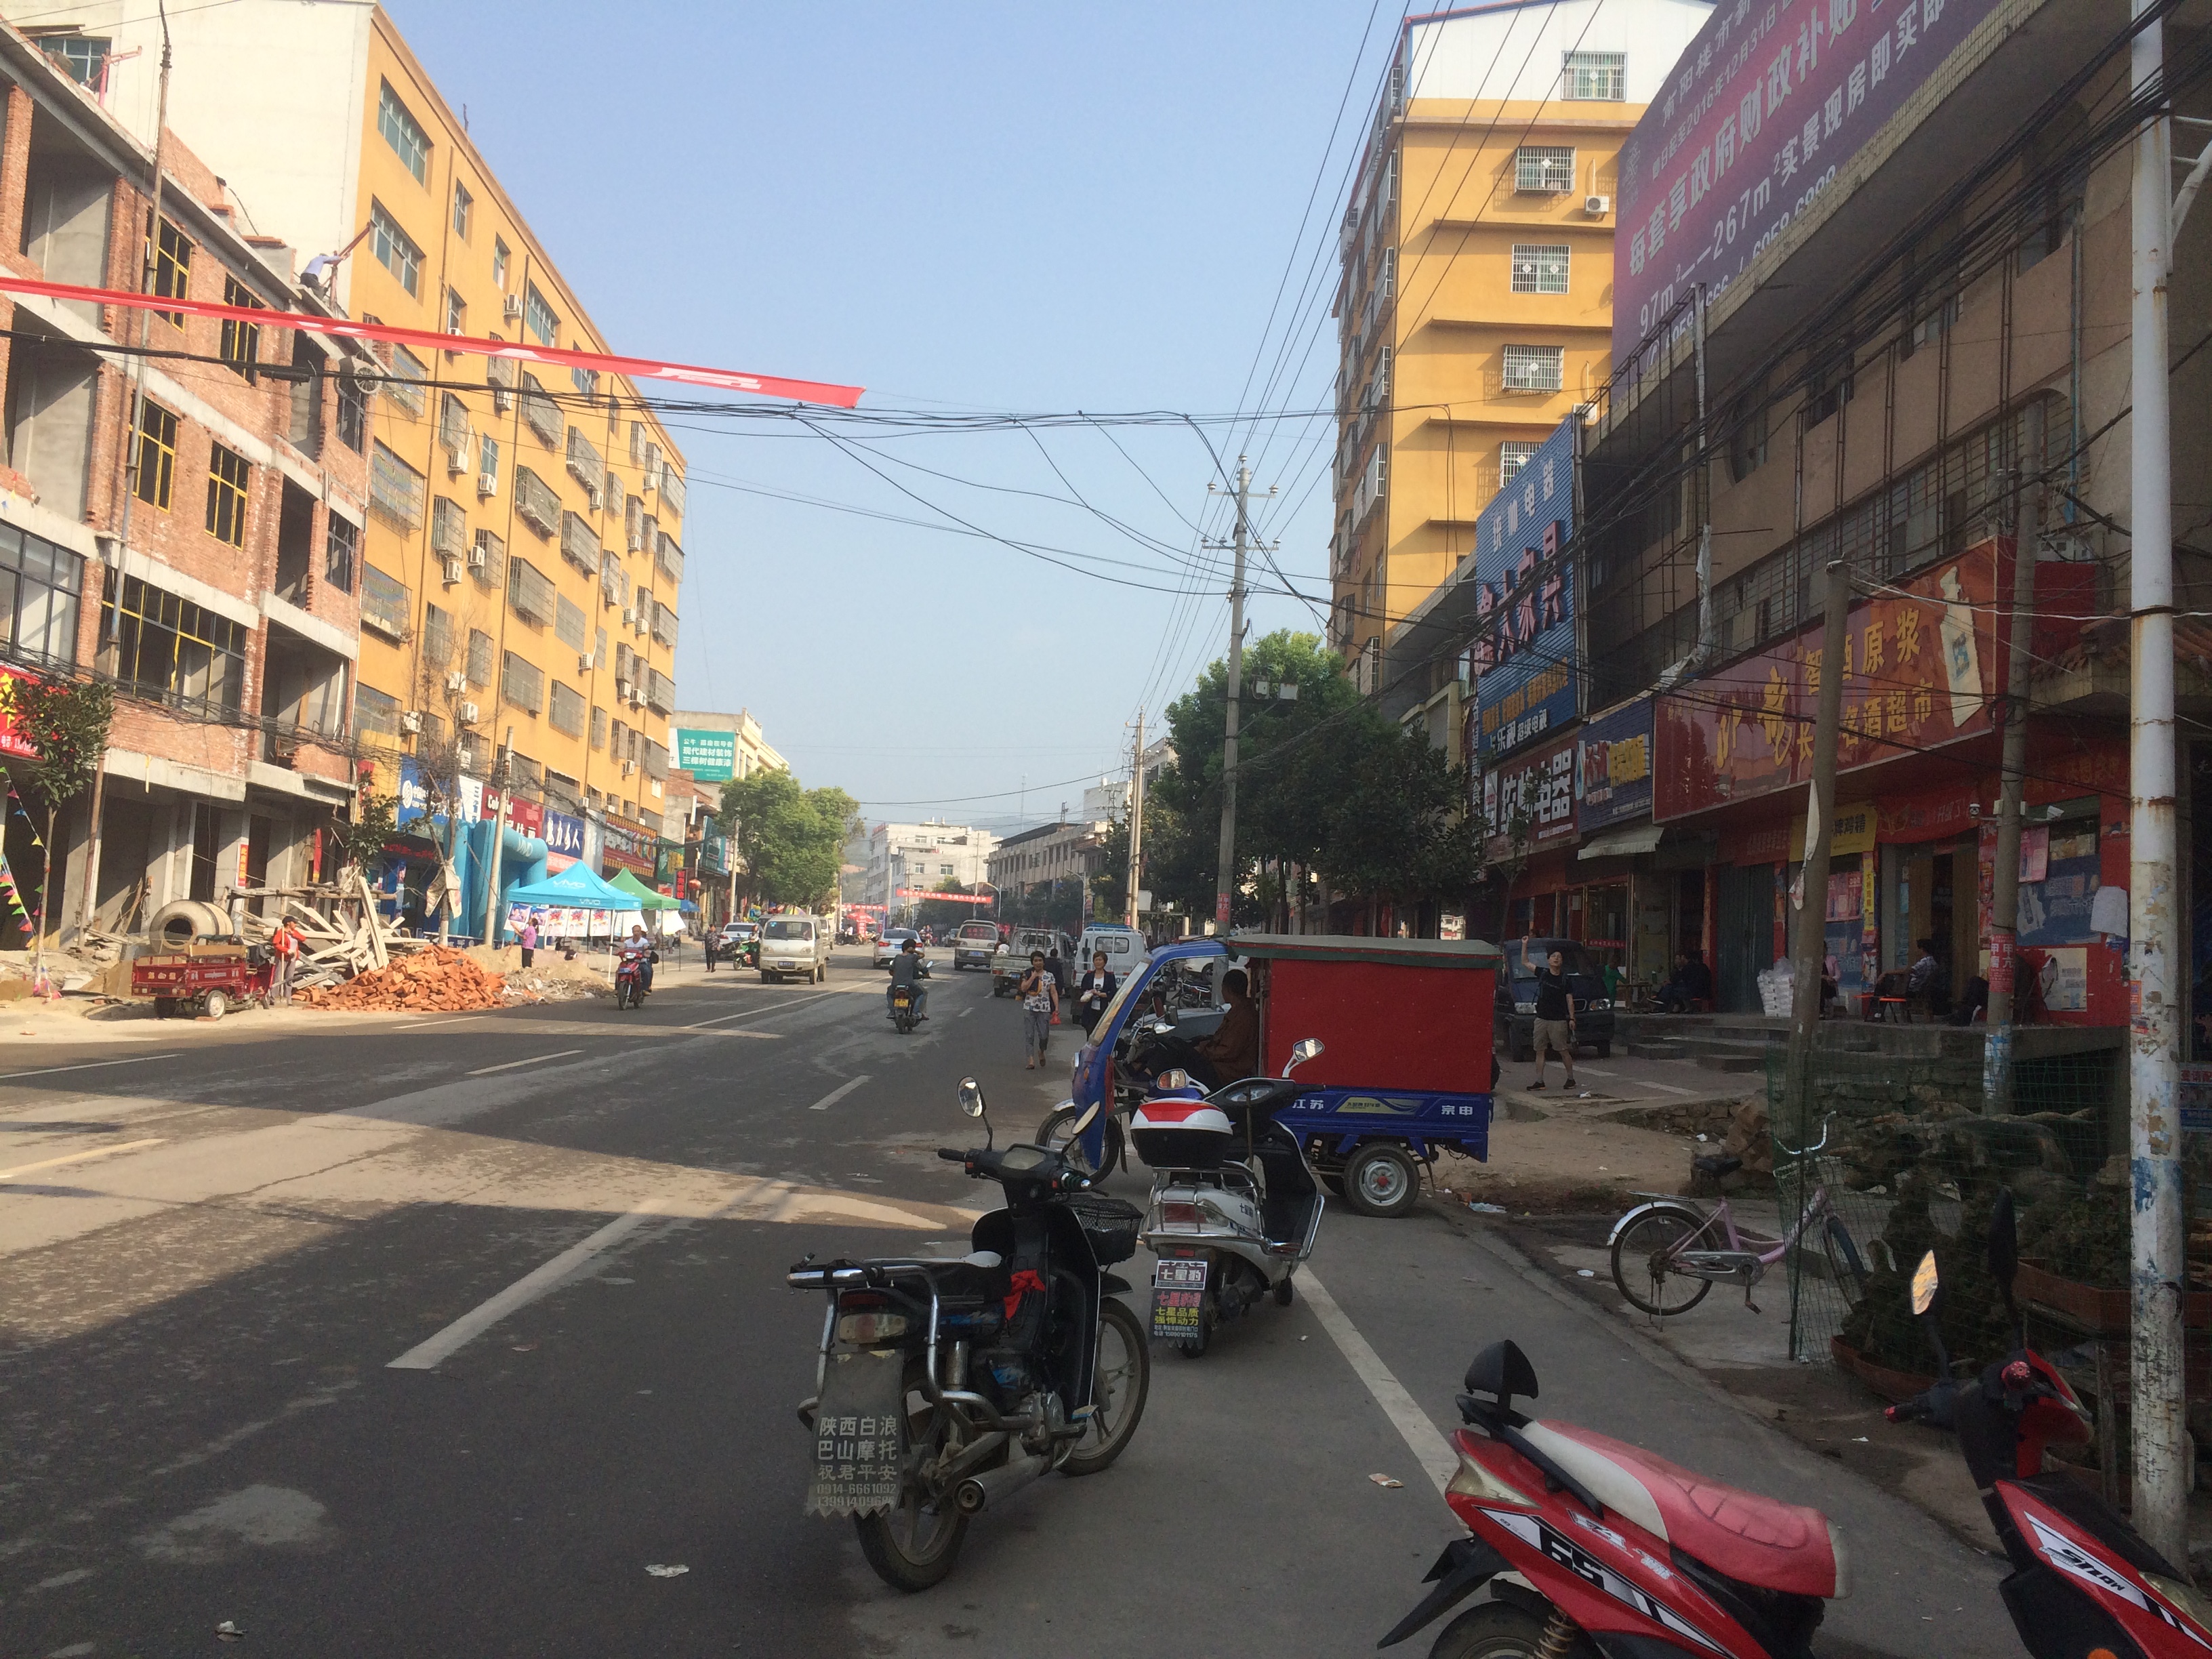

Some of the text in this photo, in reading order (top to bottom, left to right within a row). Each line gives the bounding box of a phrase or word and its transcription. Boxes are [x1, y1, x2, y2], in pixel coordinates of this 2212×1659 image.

[1797, 677, 1934, 762] 长名酒超市
[1292, 1099, 1324, 1109] 江苏
[1441, 1105, 1473, 1116] 宗申
[1160, 1269, 1202, 1282] 七星豹
[1155, 1307, 1200, 1317] 七星品质
[1154, 1315, 1199, 1326] 强悍动力
[819, 1414, 897, 1437] 陕西白浪
[817, 1439, 897, 1461] 巴山摩托
[817, 1464, 898, 1481] 祝君平安
[817, 1483, 897, 1494] 0914-6661092
